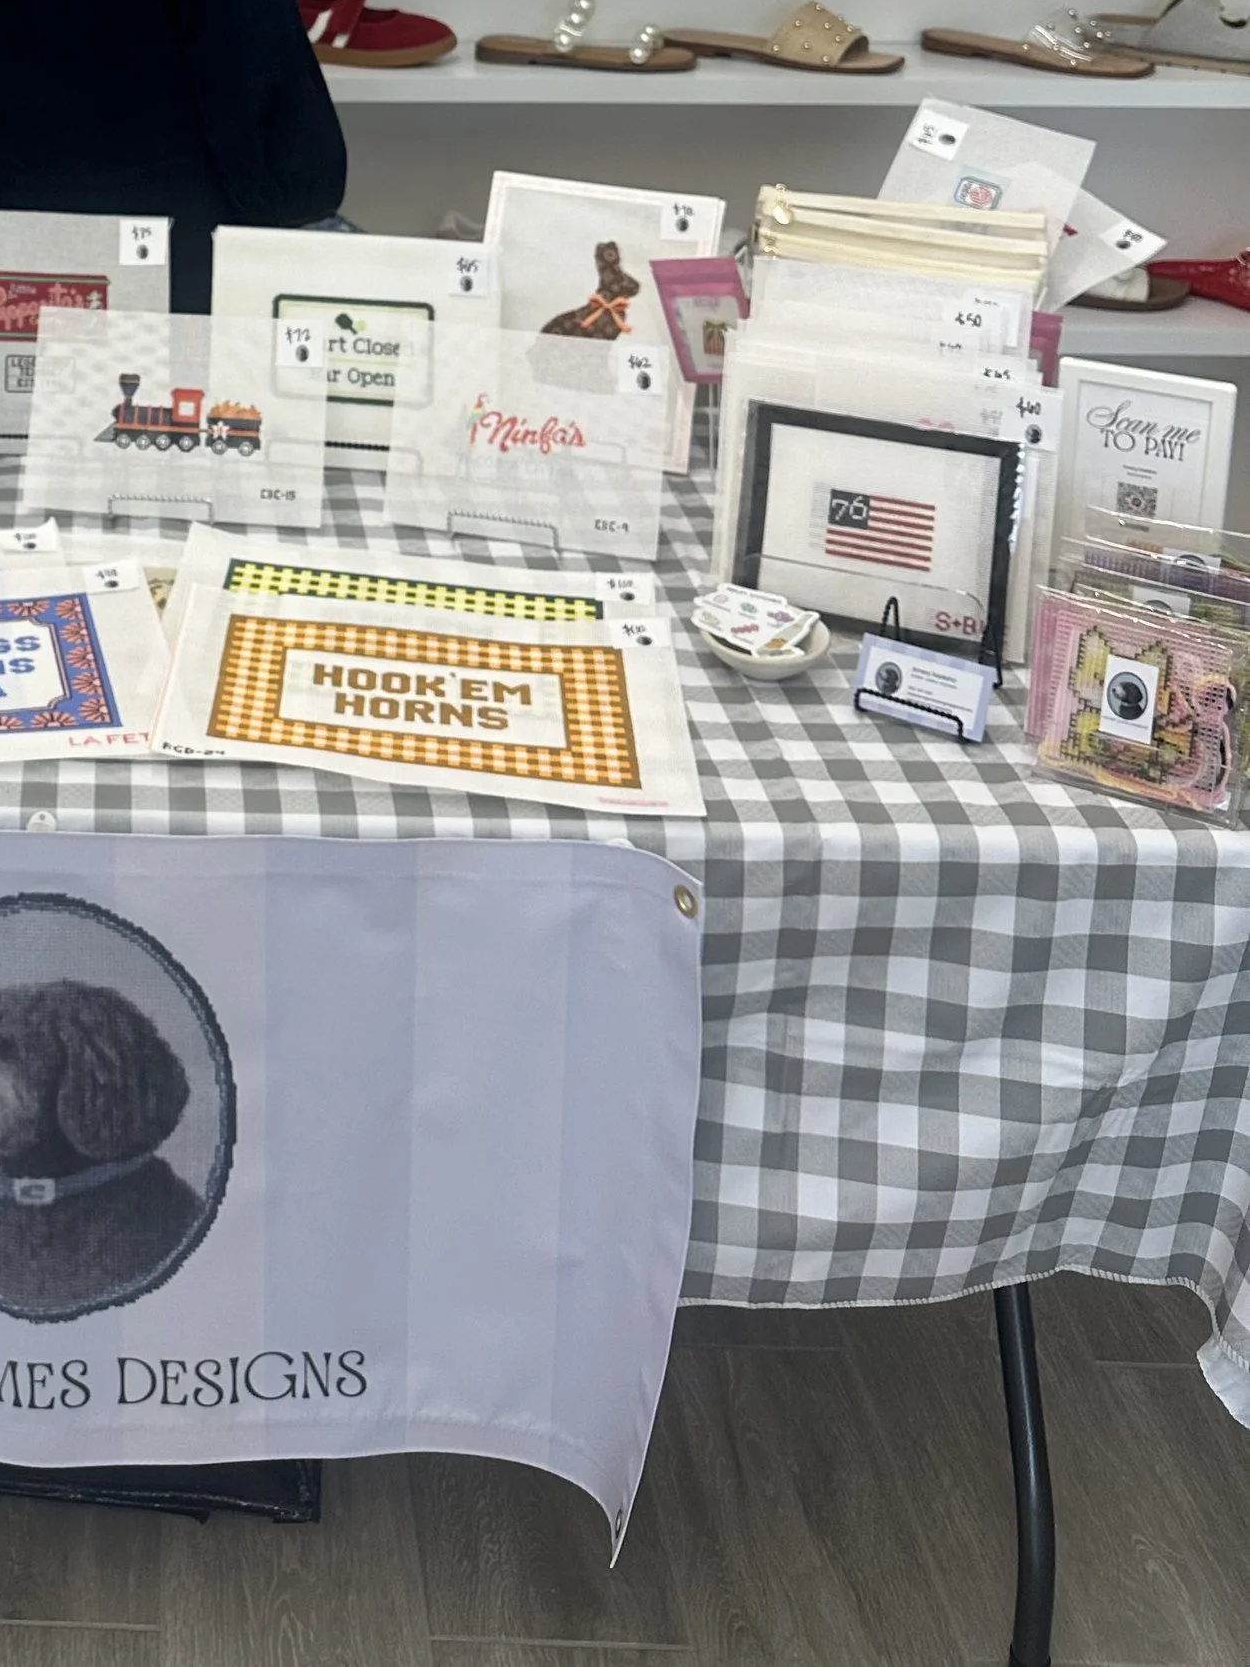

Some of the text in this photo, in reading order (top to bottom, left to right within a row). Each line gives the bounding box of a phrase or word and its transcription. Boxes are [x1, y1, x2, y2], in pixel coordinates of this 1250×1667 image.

[347, 367, 396, 387] Open
[477, 410, 586, 455] Ninfa's
[1086, 399, 1202, 444] Scan me
[1100, 427, 1136, 453] TO
[831, 495, 868, 522] 76
[313, 662, 446, 698] HOOK
[334, 691, 509, 731] HORNS
[116, 1348, 368, 1408] DESIGNS
